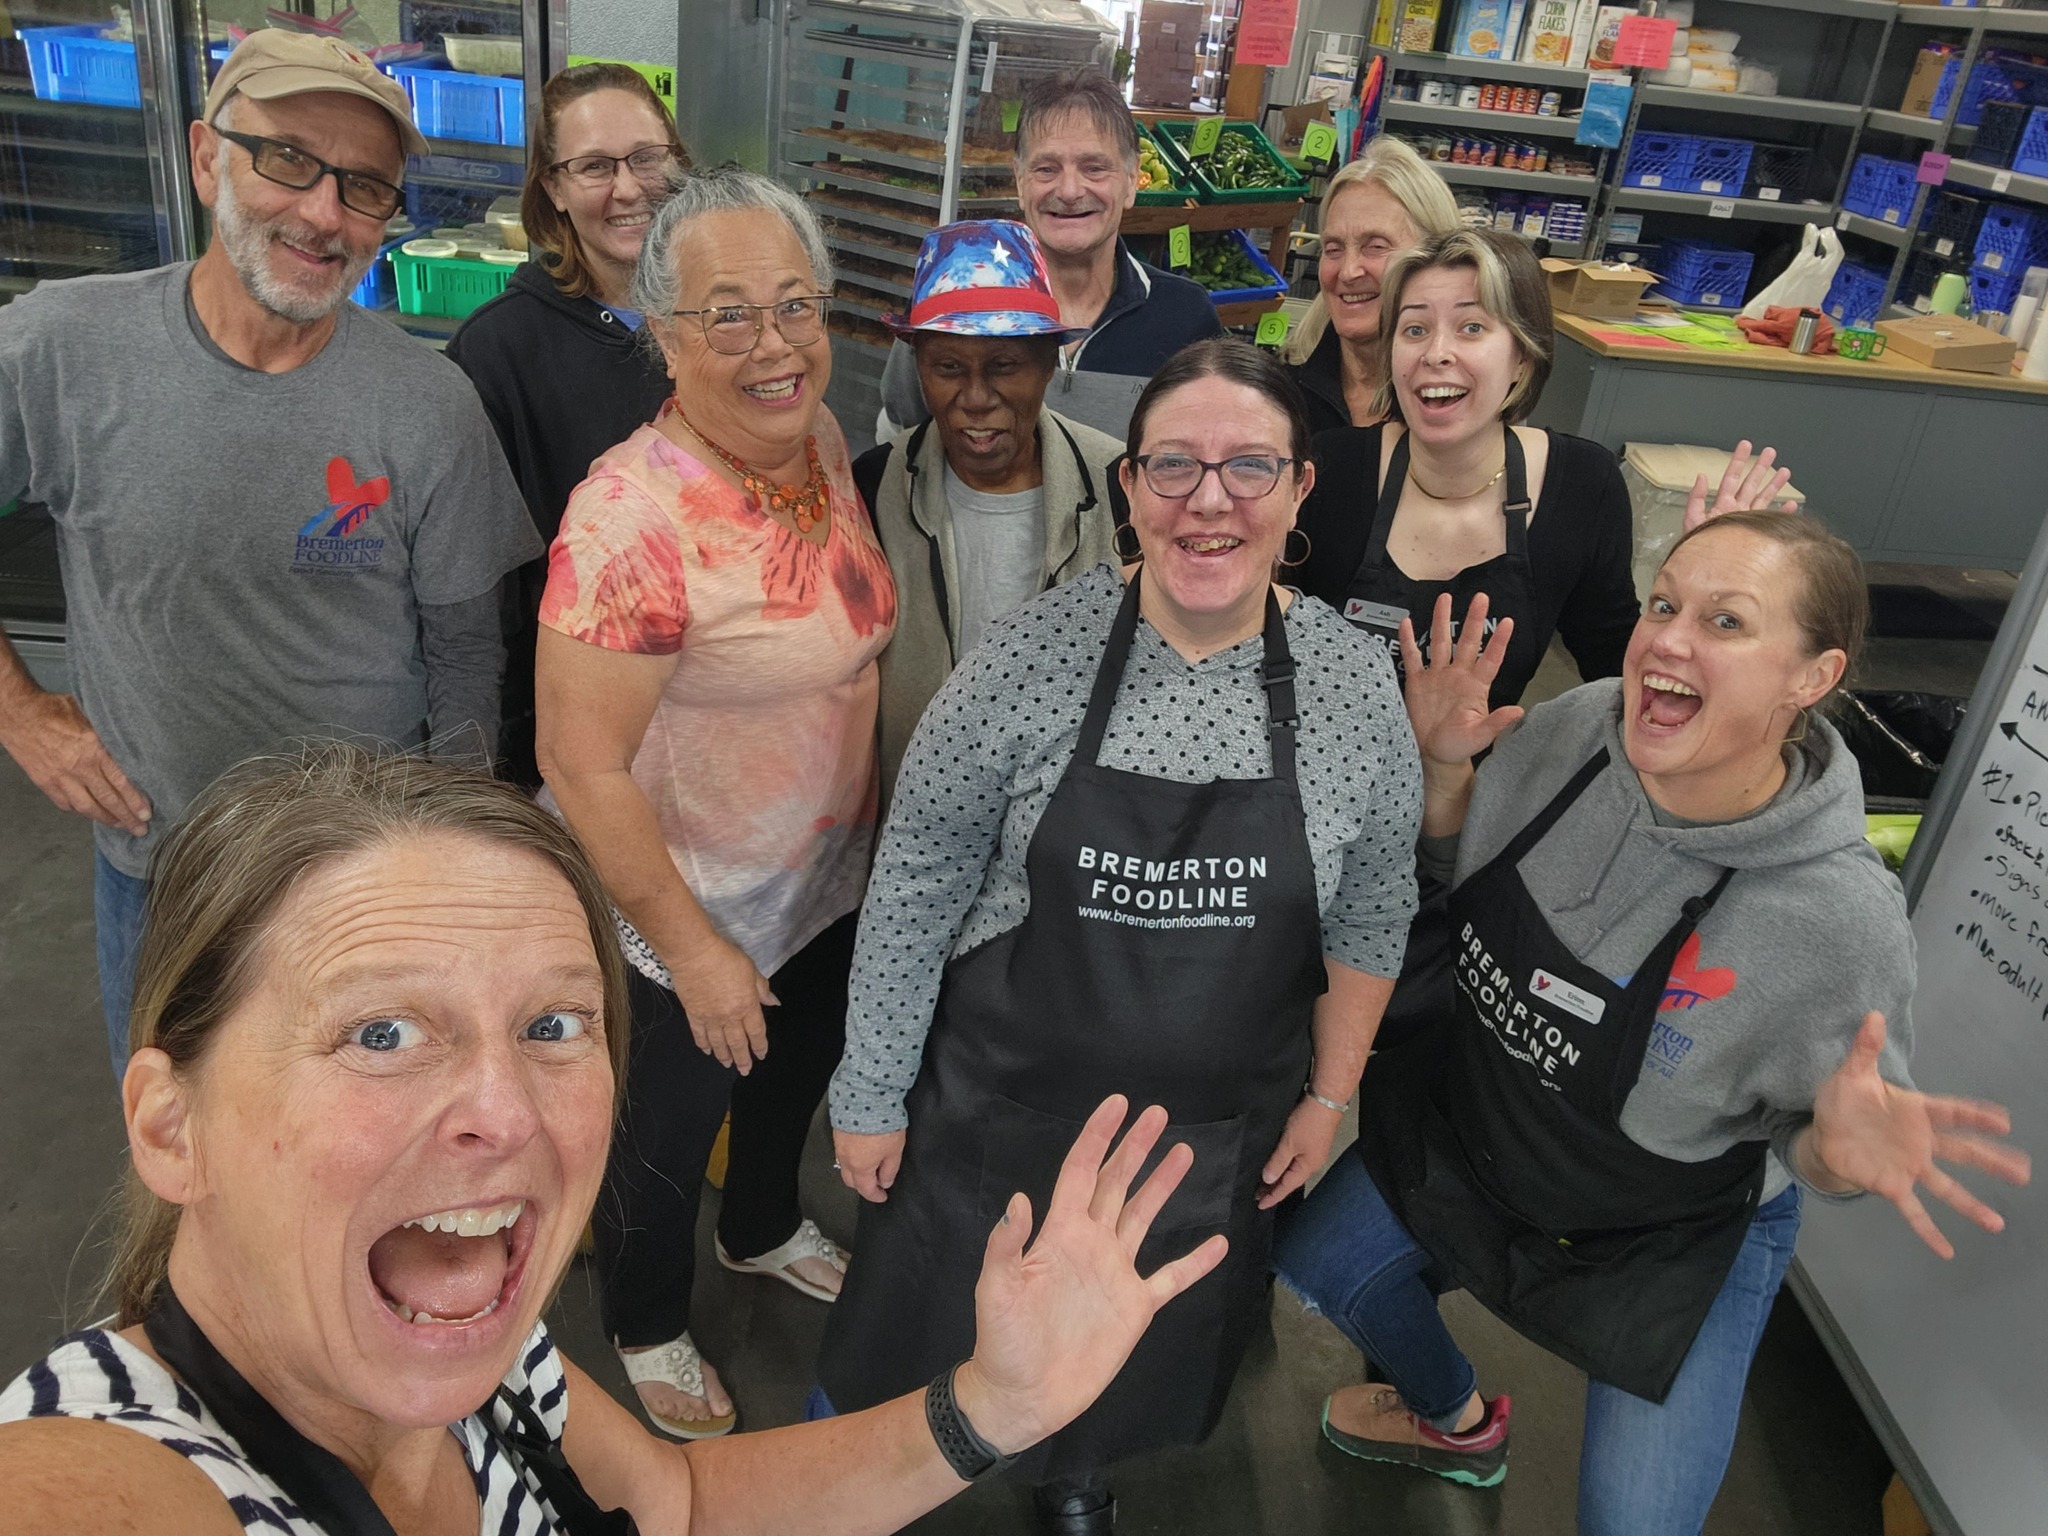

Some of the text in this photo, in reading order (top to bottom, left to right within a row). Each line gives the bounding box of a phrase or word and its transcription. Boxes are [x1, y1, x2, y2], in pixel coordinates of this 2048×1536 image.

[1408, 5, 1426, 15] Oats
[1545, 1, 1567, 17] CORN
[1538, 15, 1567, 31] FLAKES
[1202, 128, 1212, 141] 3
[1314, 136, 1324, 149] 2
[1177, 240, 1184, 254] 2
[1268, 323, 1277, 335] 5
[297, 535, 384, 551] Bremerton
[294, 549, 381, 565] FOODLINE
[1078, 846, 1267, 882] BREMERTON
[1996, 855, 2041, 901] Signs
[1091, 879, 1248, 910] FOODLINE
[1078, 905, 1256, 929] www.bremertonfoodline.org
[1461, 922, 1581, 1067] BREMERTON
[1459, 952, 1558, 1075] FOODLINE
